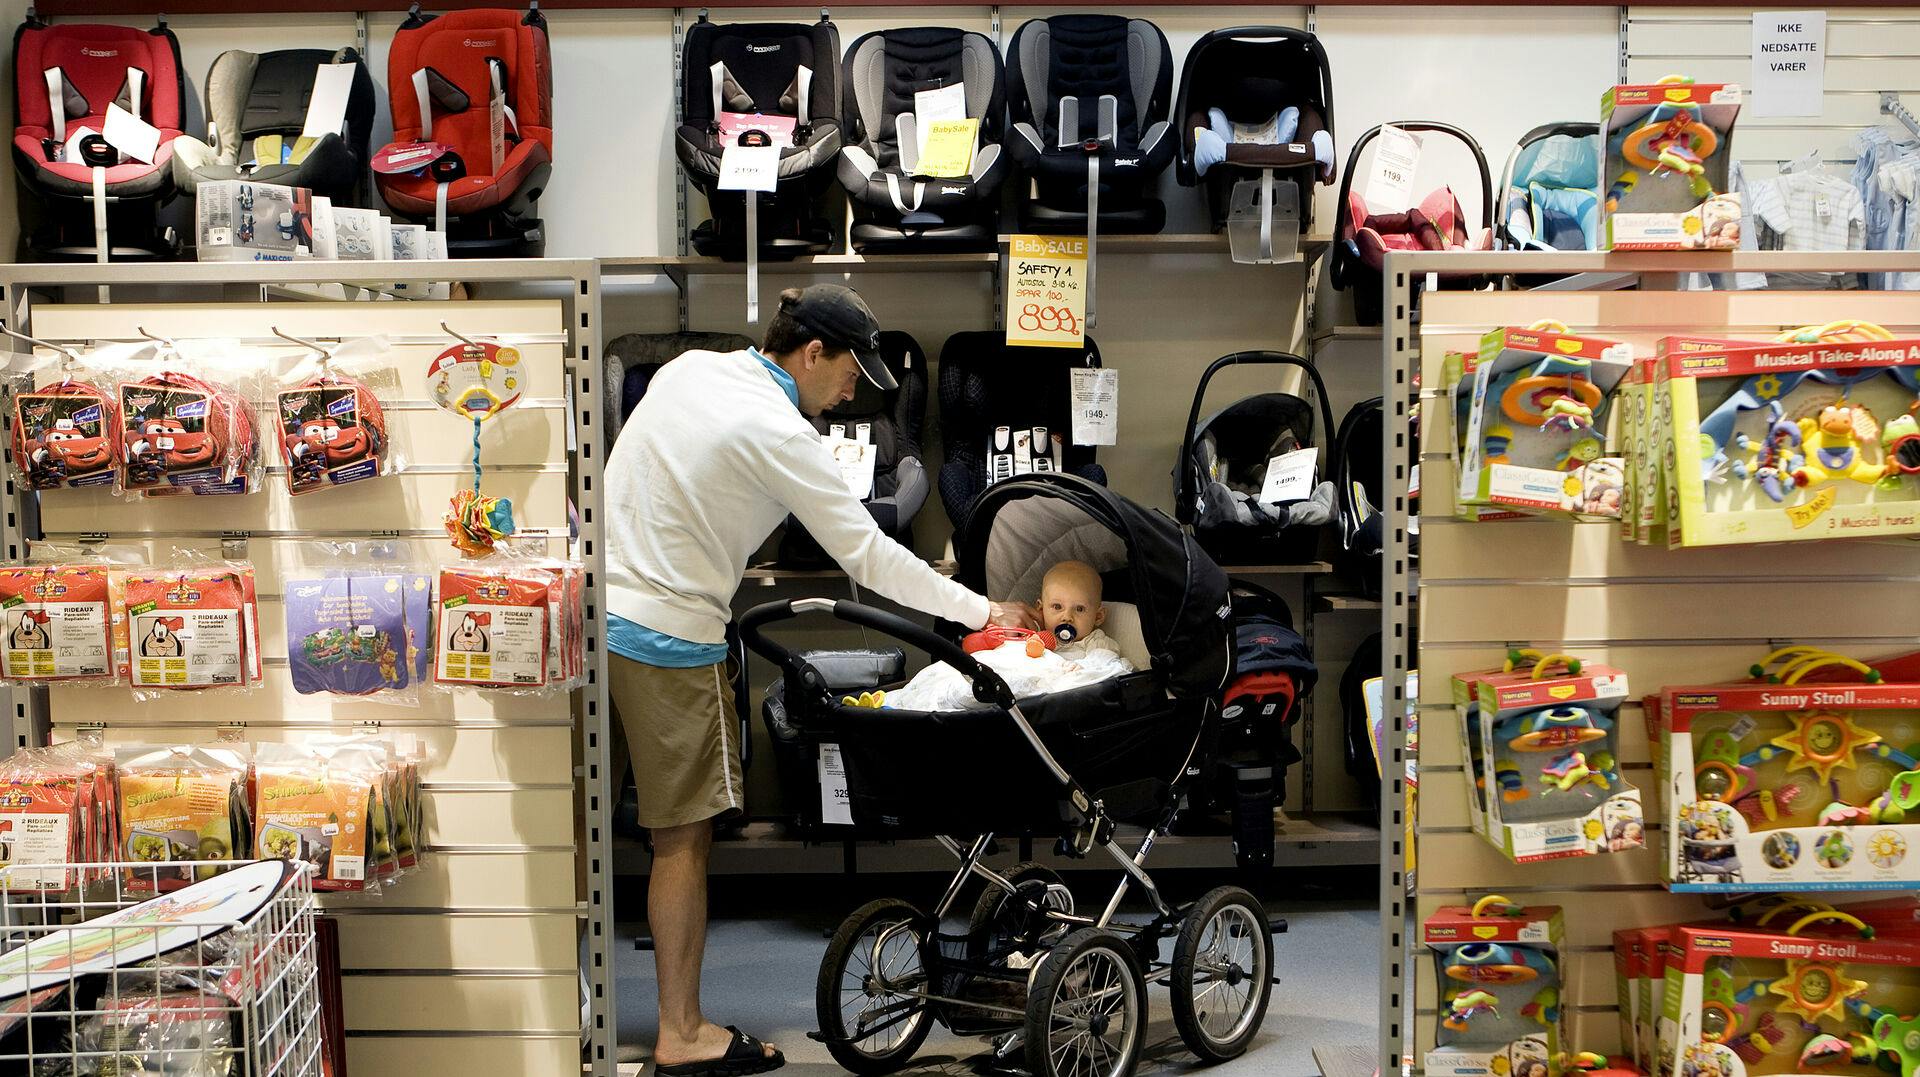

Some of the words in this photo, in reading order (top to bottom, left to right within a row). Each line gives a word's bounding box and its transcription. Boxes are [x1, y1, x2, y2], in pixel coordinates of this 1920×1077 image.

[1777, 24, 1802, 33] IKKE
[1761, 43, 1817, 53] NEDSATTE
[1770, 62, 1806, 72] VARER
[1016, 261, 1061, 279] SAFETY
[1016, 289, 1042, 298] SPAR
[1681, 358, 1702, 369] TINY
[1702, 357, 1726, 367] LOVE
[1754, 351, 1814, 367] Musical
[1817, 347, 1905, 364] Take-Along
[1794, 509, 1810, 521] Try
[1829, 518, 1836, 528] 3
[1840, 516, 1880, 528] Musical
[1885, 515, 1915, 525] tunes
[1760, 692, 1808, 708] Sunny
[1812, 691, 1856, 705] Stroll
[1770, 940, 1814, 958] Sunny
[1817, 943, 1857, 958] Stroll
